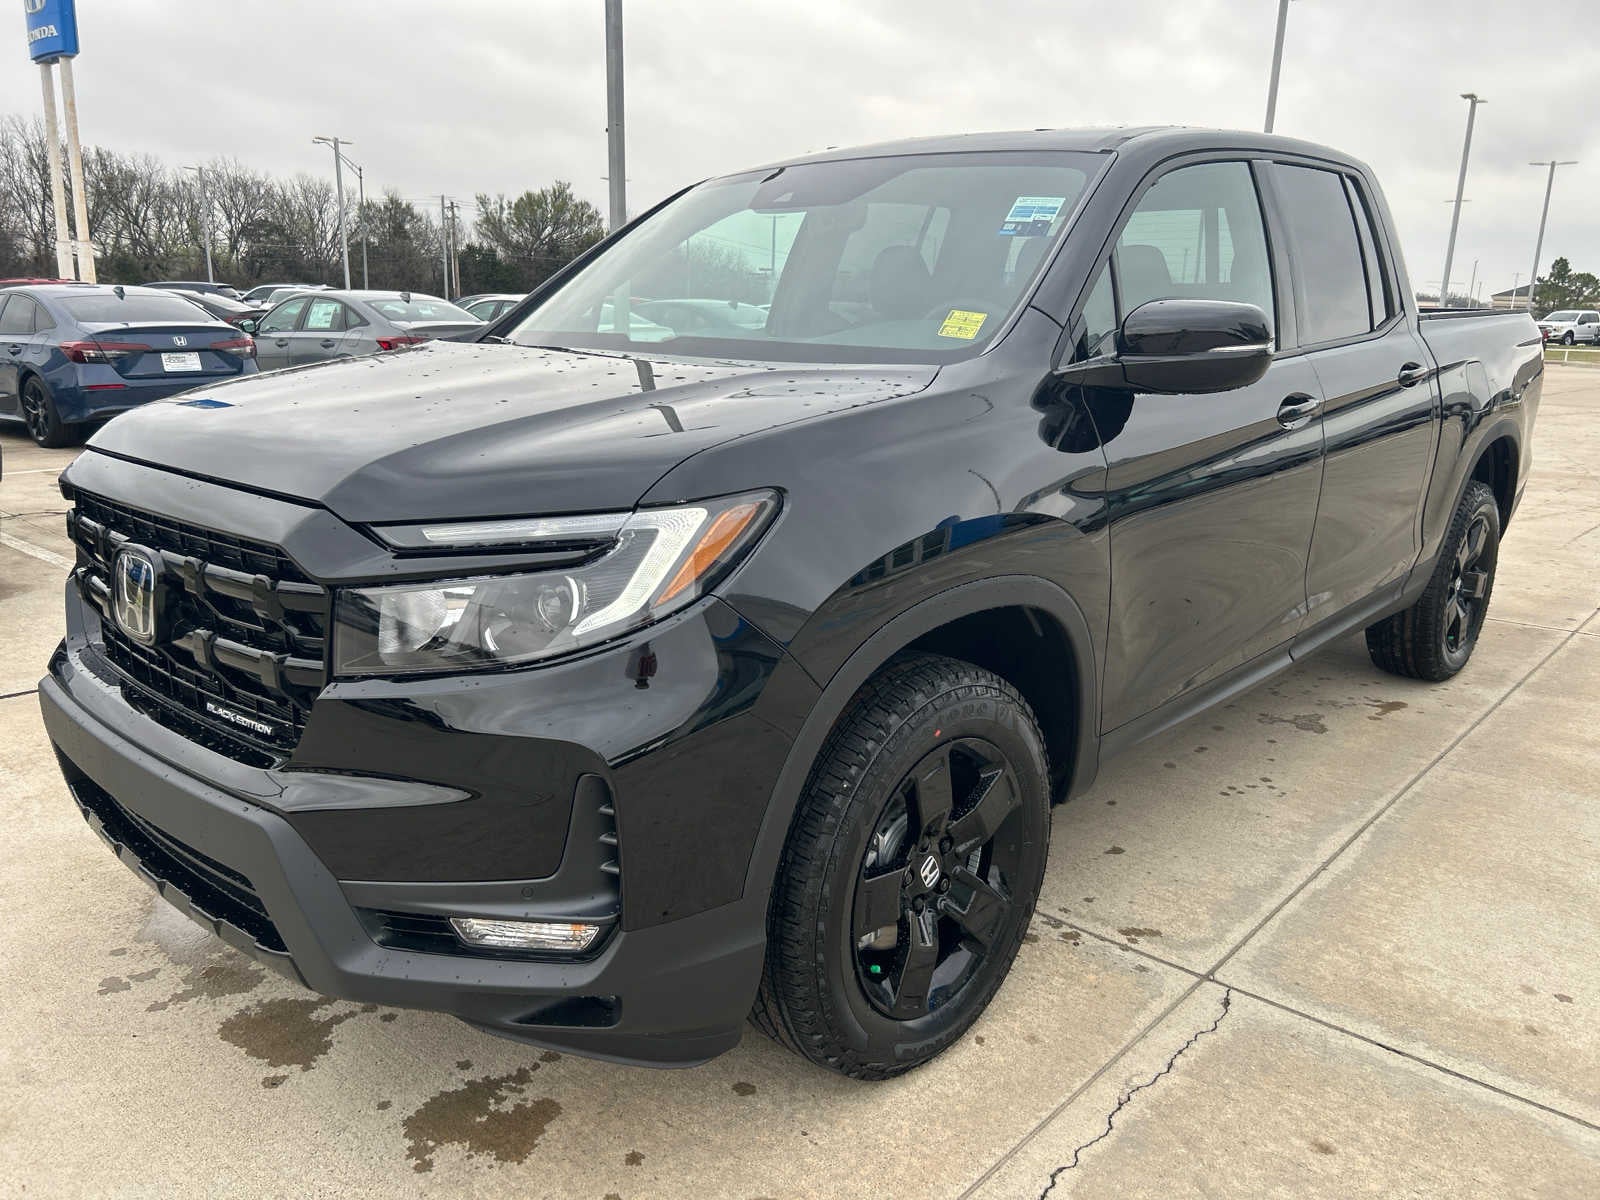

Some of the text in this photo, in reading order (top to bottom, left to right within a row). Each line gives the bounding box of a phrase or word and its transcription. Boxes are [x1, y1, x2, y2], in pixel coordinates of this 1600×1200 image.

[28, 24, 58, 42] ONDA
[206, 702, 273, 735] BLACK EDITION
